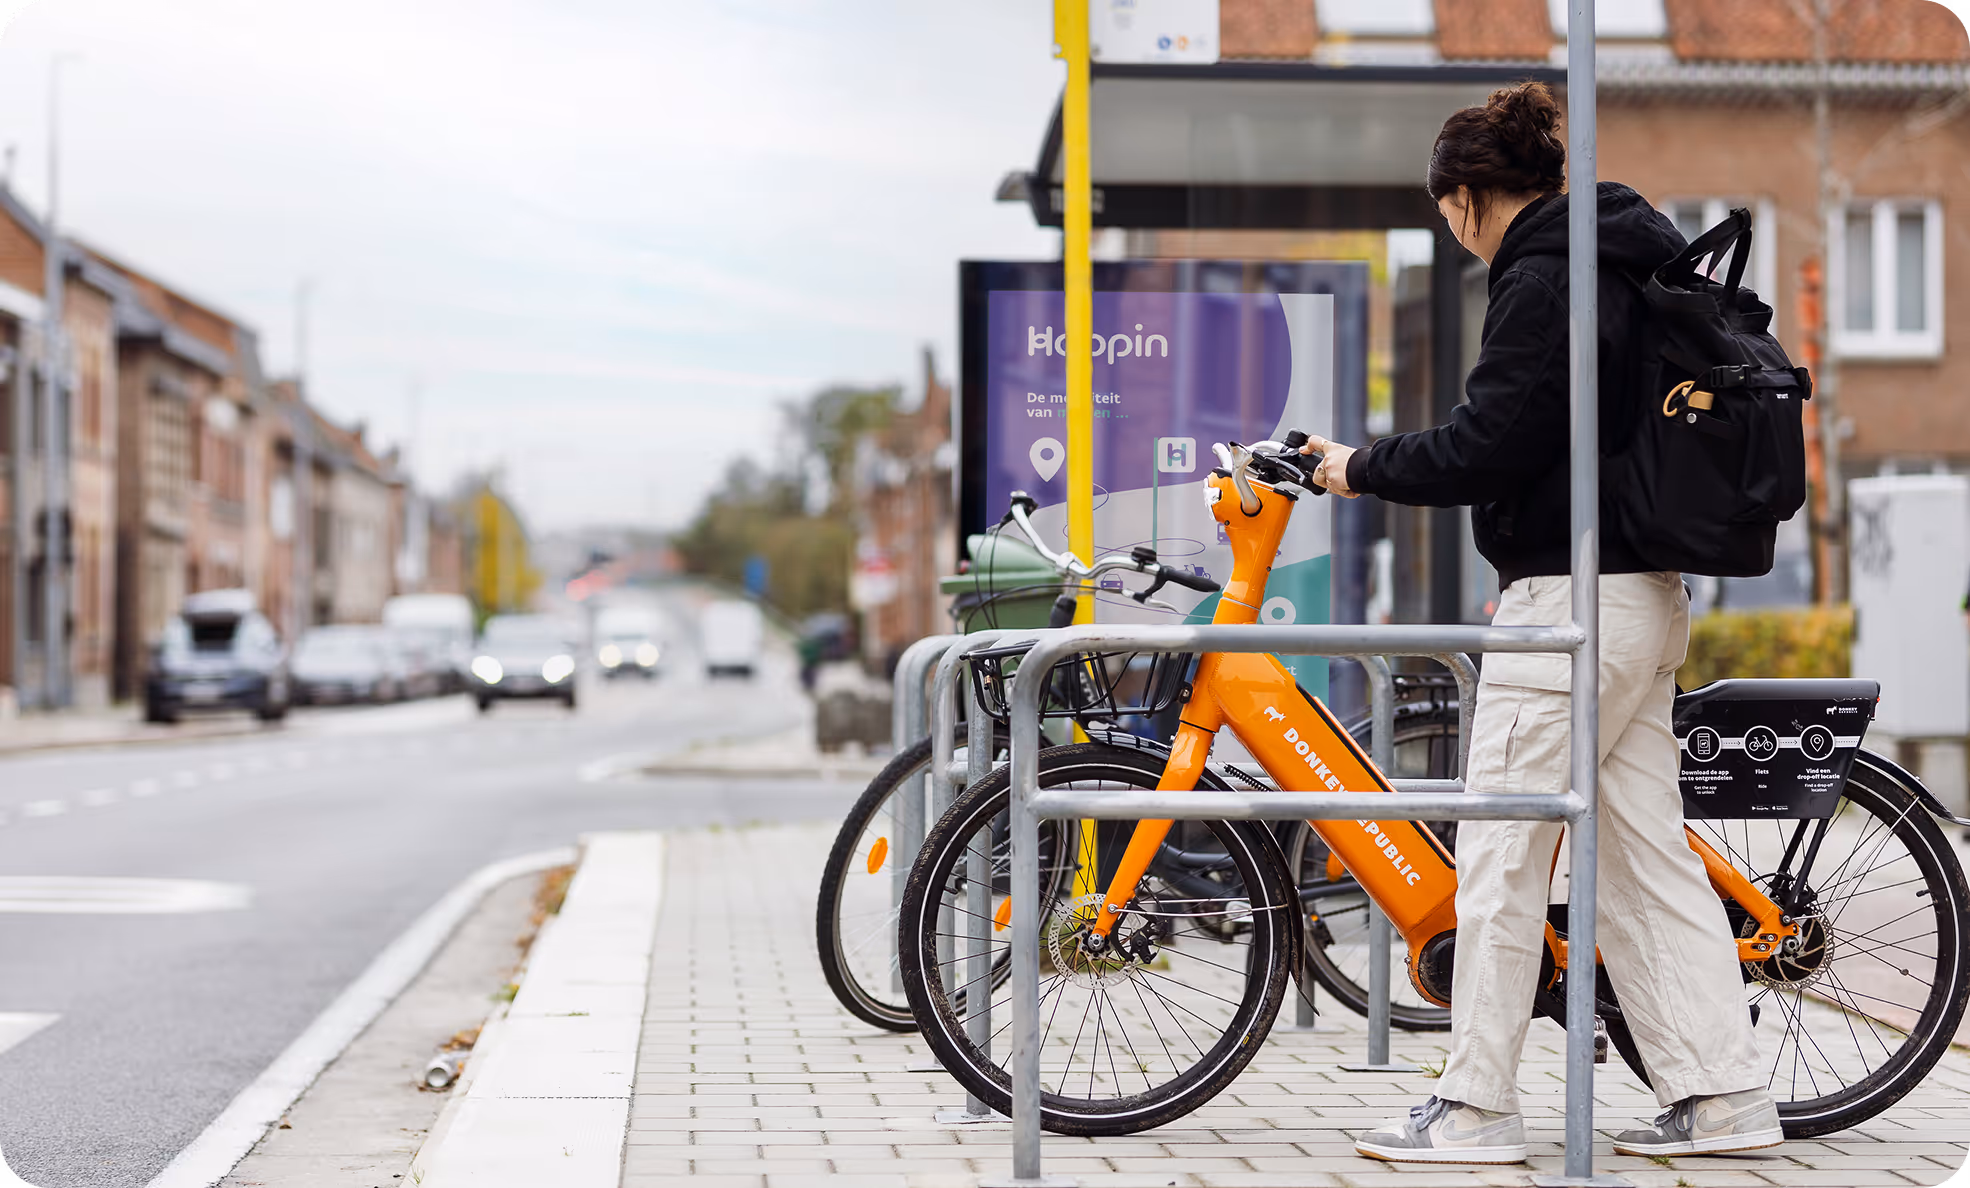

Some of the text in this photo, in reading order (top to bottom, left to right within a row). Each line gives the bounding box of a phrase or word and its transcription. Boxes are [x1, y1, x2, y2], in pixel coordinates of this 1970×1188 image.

[1027, 392, 1121, 404] De miteit
[1027, 408, 1052, 418] van
[1355, 819, 1421, 887] PUBLIC
